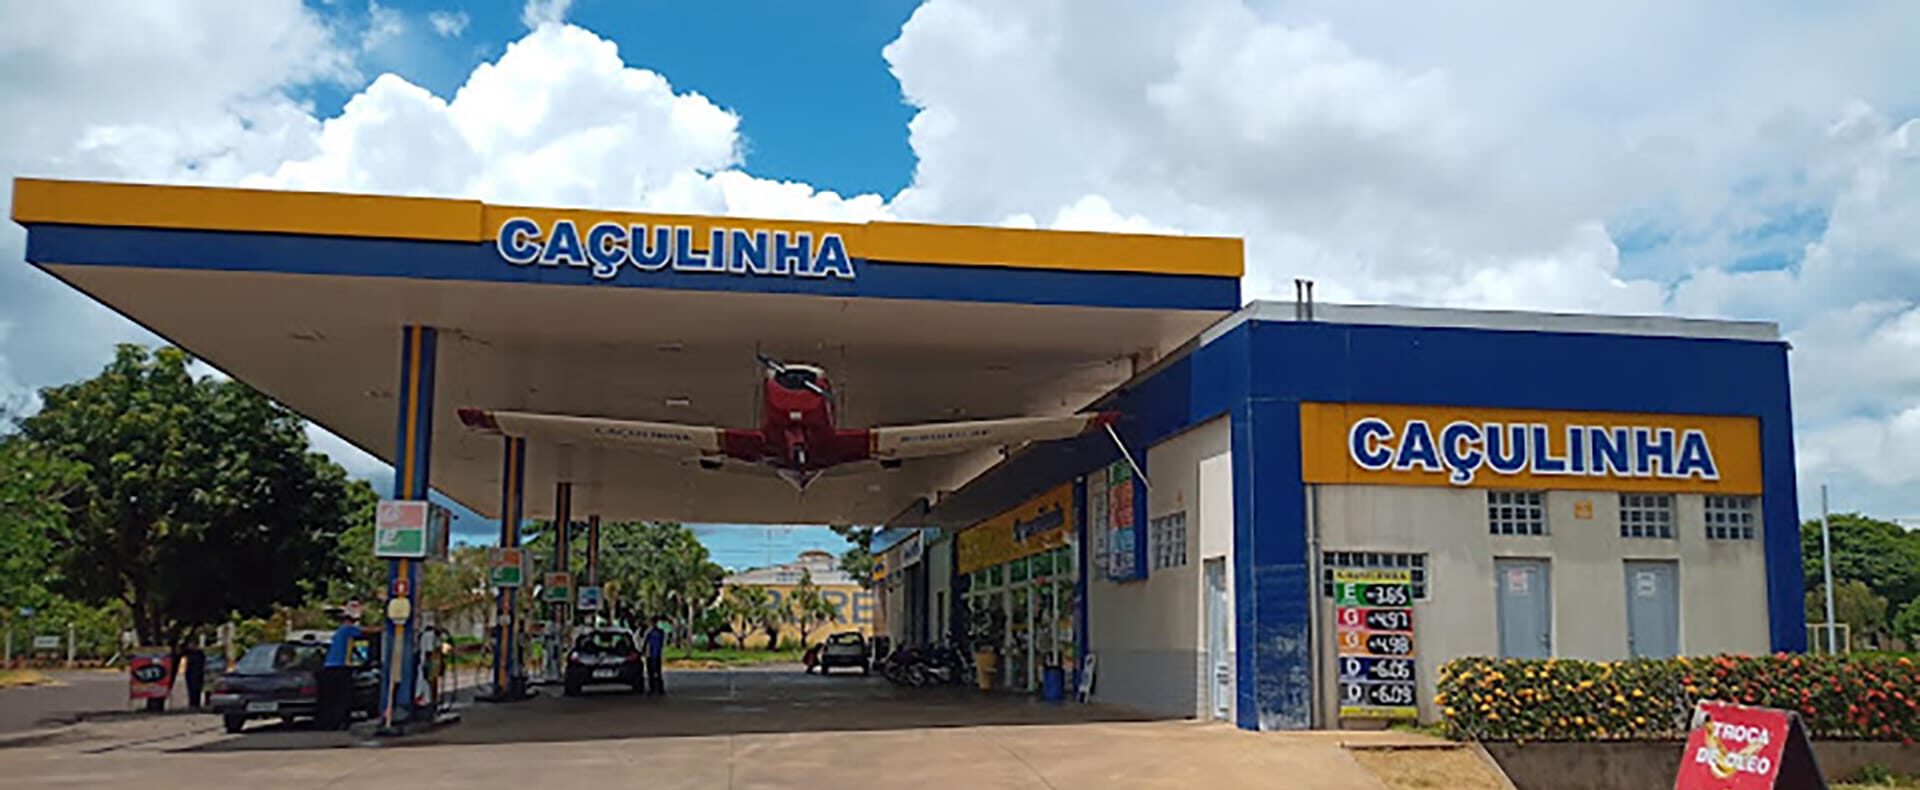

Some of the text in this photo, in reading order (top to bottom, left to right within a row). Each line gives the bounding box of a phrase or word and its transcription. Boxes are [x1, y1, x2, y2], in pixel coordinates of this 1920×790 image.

[497, 216, 855, 279] CAÇULINHA
[1348, 417, 1719, 485] CAÇULINHA
[1344, 584, 1356, 599] E
[1344, 608, 1359, 625] G
[1346, 659, 1361, 676] D
[1348, 684, 1362, 702] D
[1712, 720, 1770, 744] TROCA
